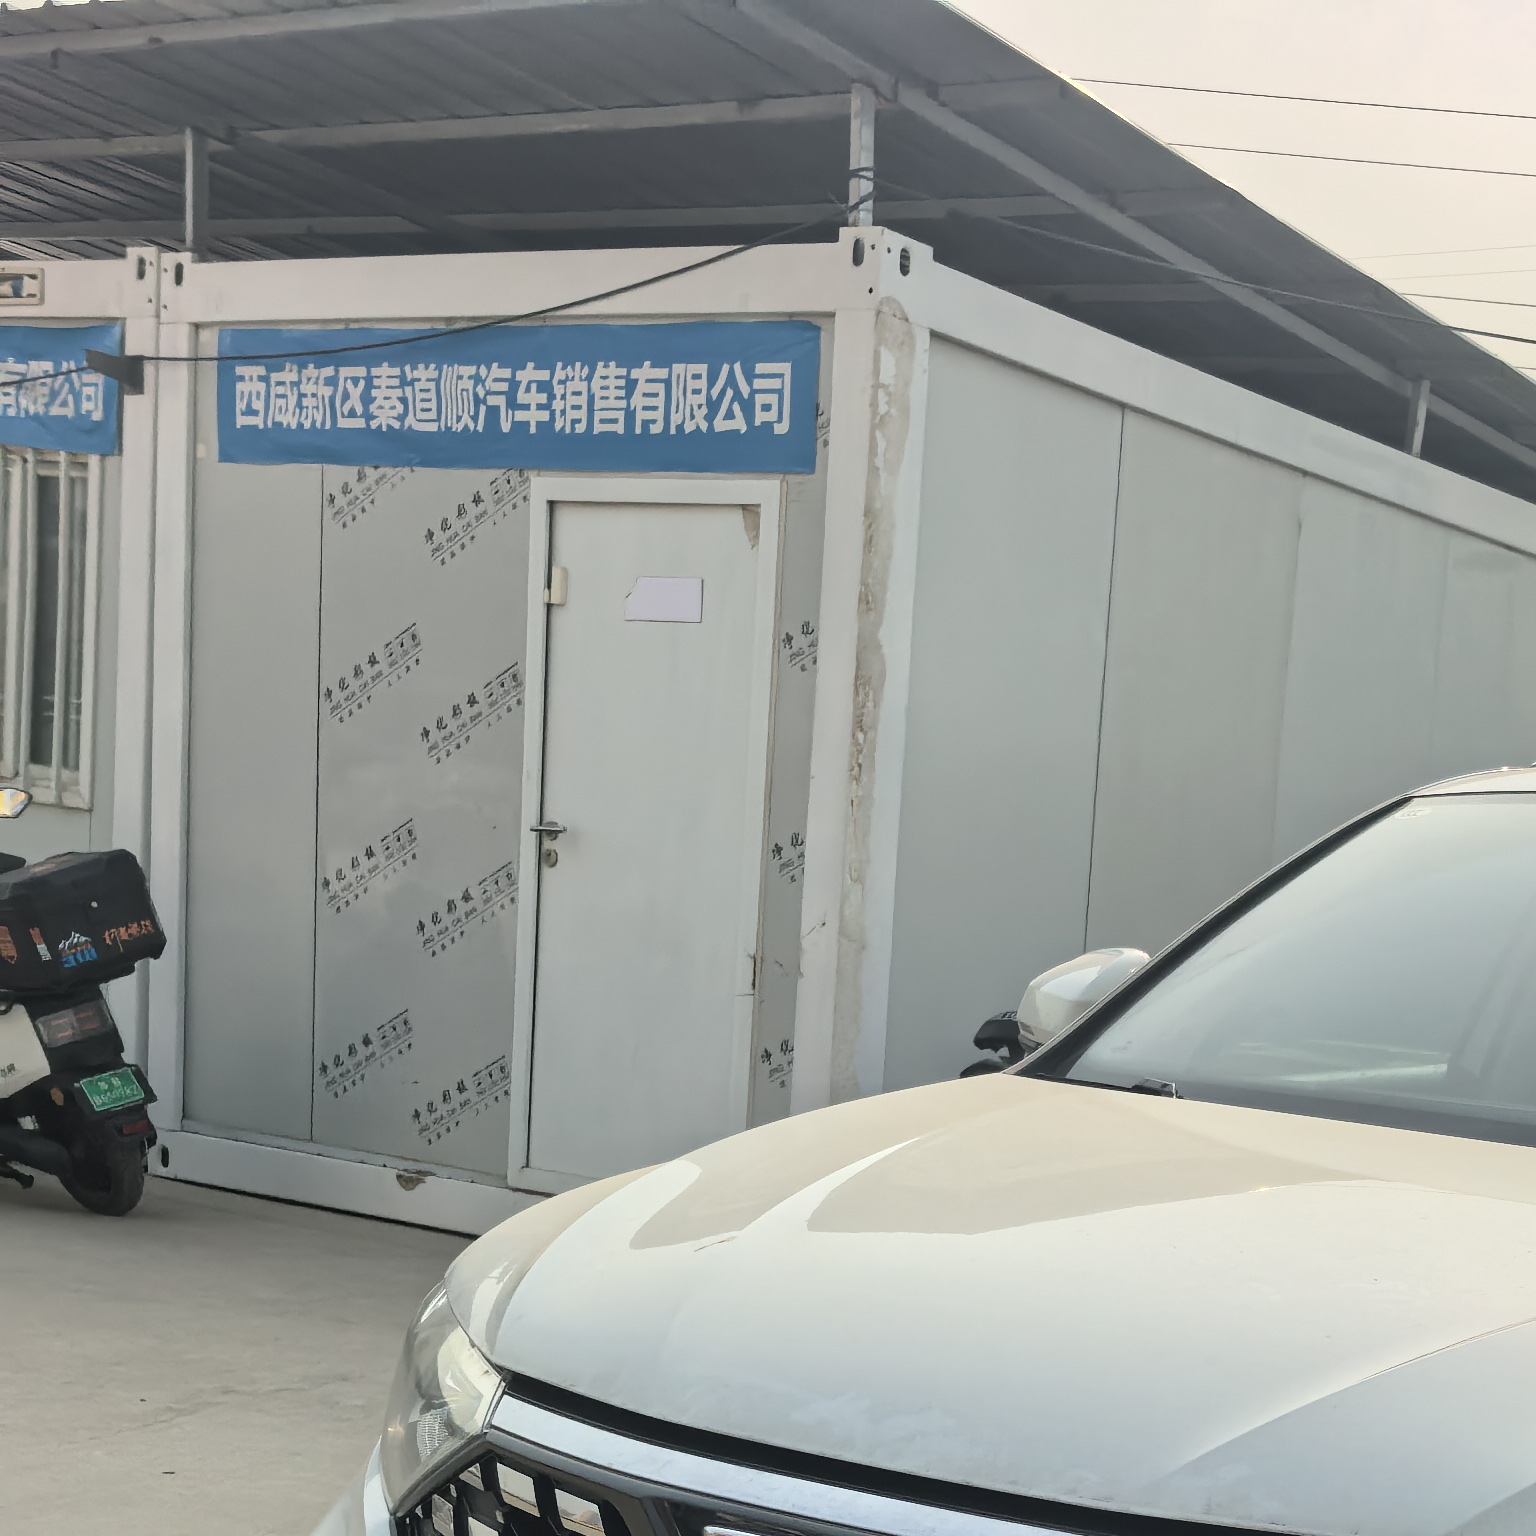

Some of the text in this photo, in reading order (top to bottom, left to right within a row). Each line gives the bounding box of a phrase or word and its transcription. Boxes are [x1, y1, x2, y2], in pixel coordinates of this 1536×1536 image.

[0, 357, 105, 422] 有限公司
[235, 360, 792, 435] 西咸新区秦道顺汽车销售有限公司
